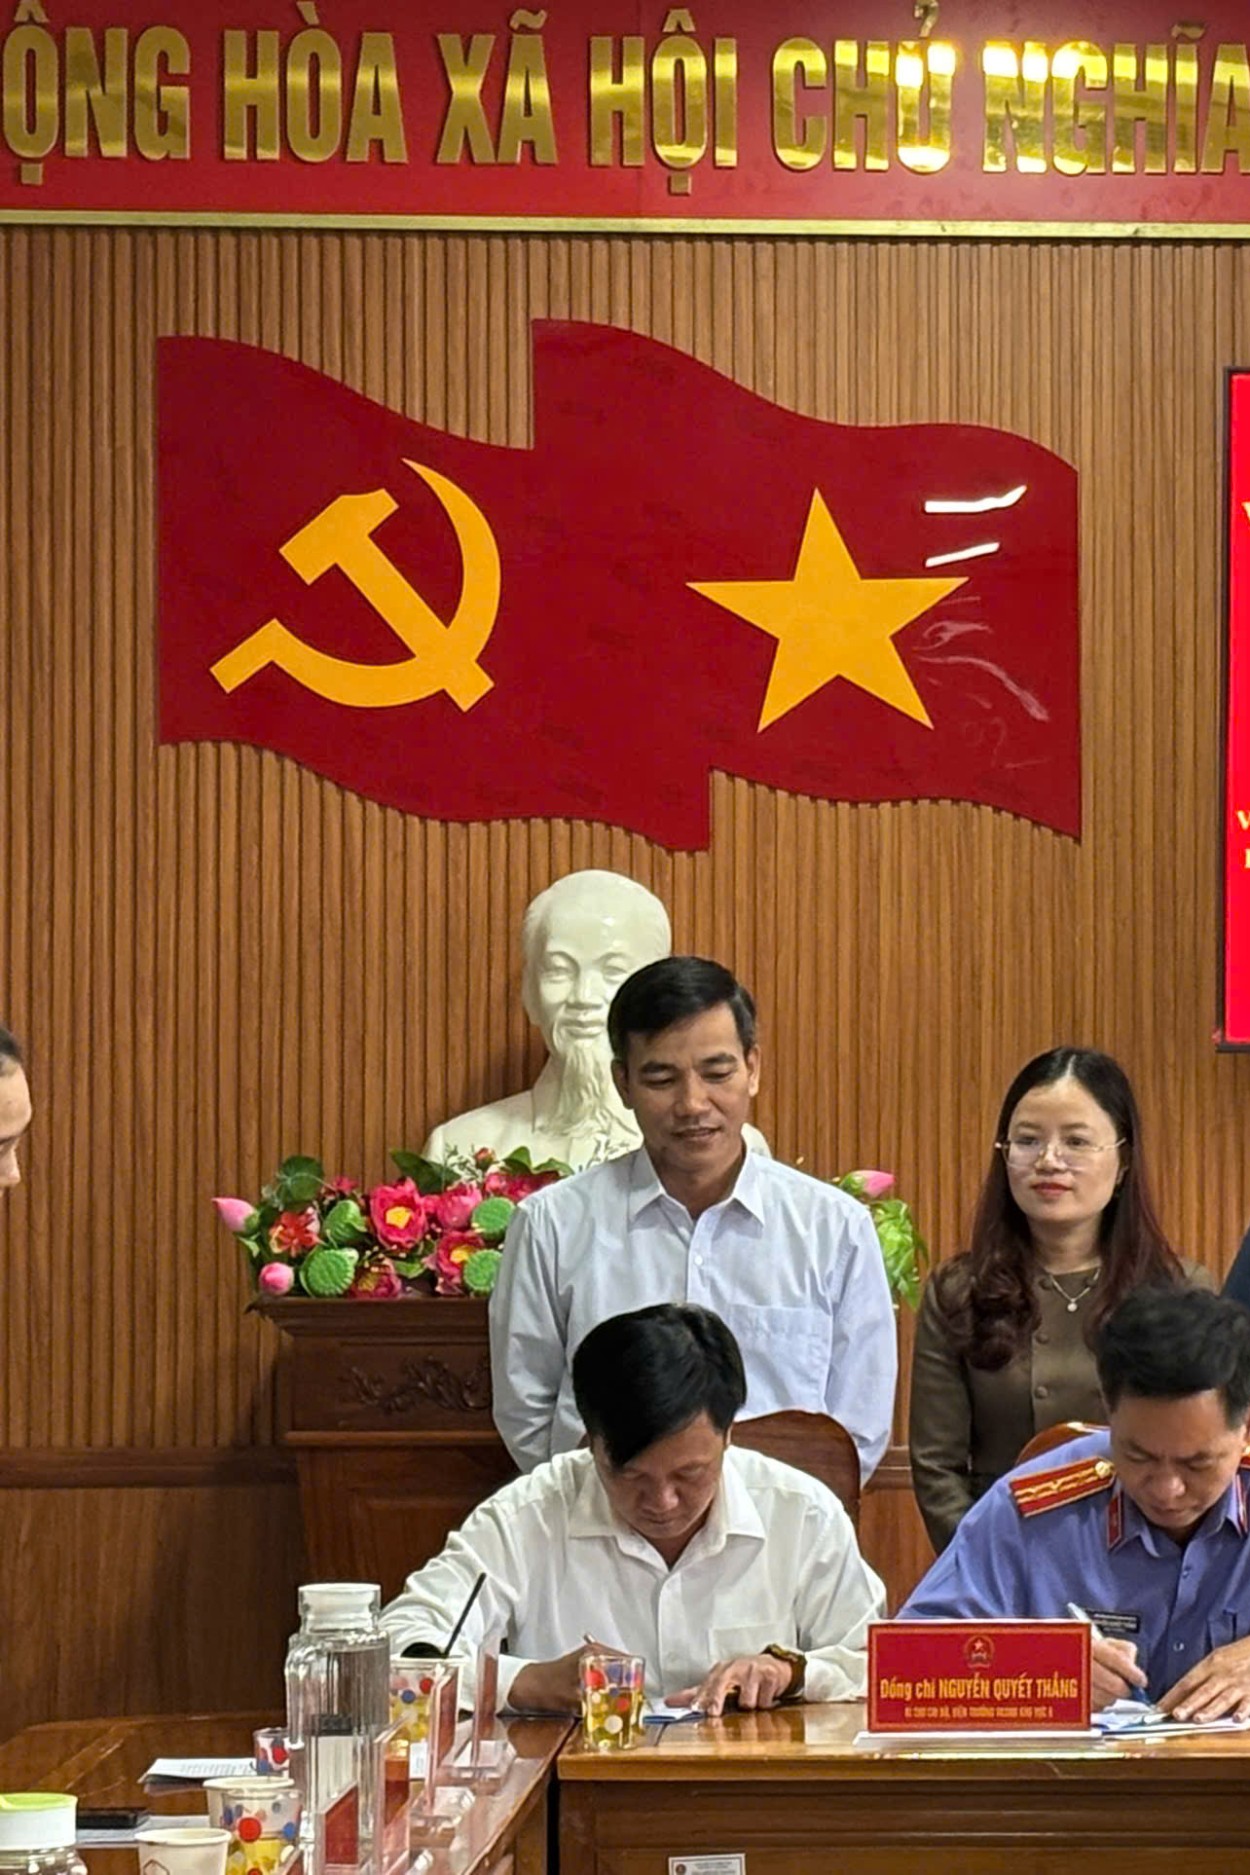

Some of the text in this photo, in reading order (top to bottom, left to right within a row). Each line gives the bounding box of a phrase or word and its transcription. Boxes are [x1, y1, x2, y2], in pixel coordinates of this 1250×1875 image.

[2, 0, 192, 185] ỘNG
[224, 1, 408, 164] HÒA
[437, 9, 558, 166] XÃ
[590, 8, 739, 195] HỘI
[773, 0, 956, 174] CHỦ
